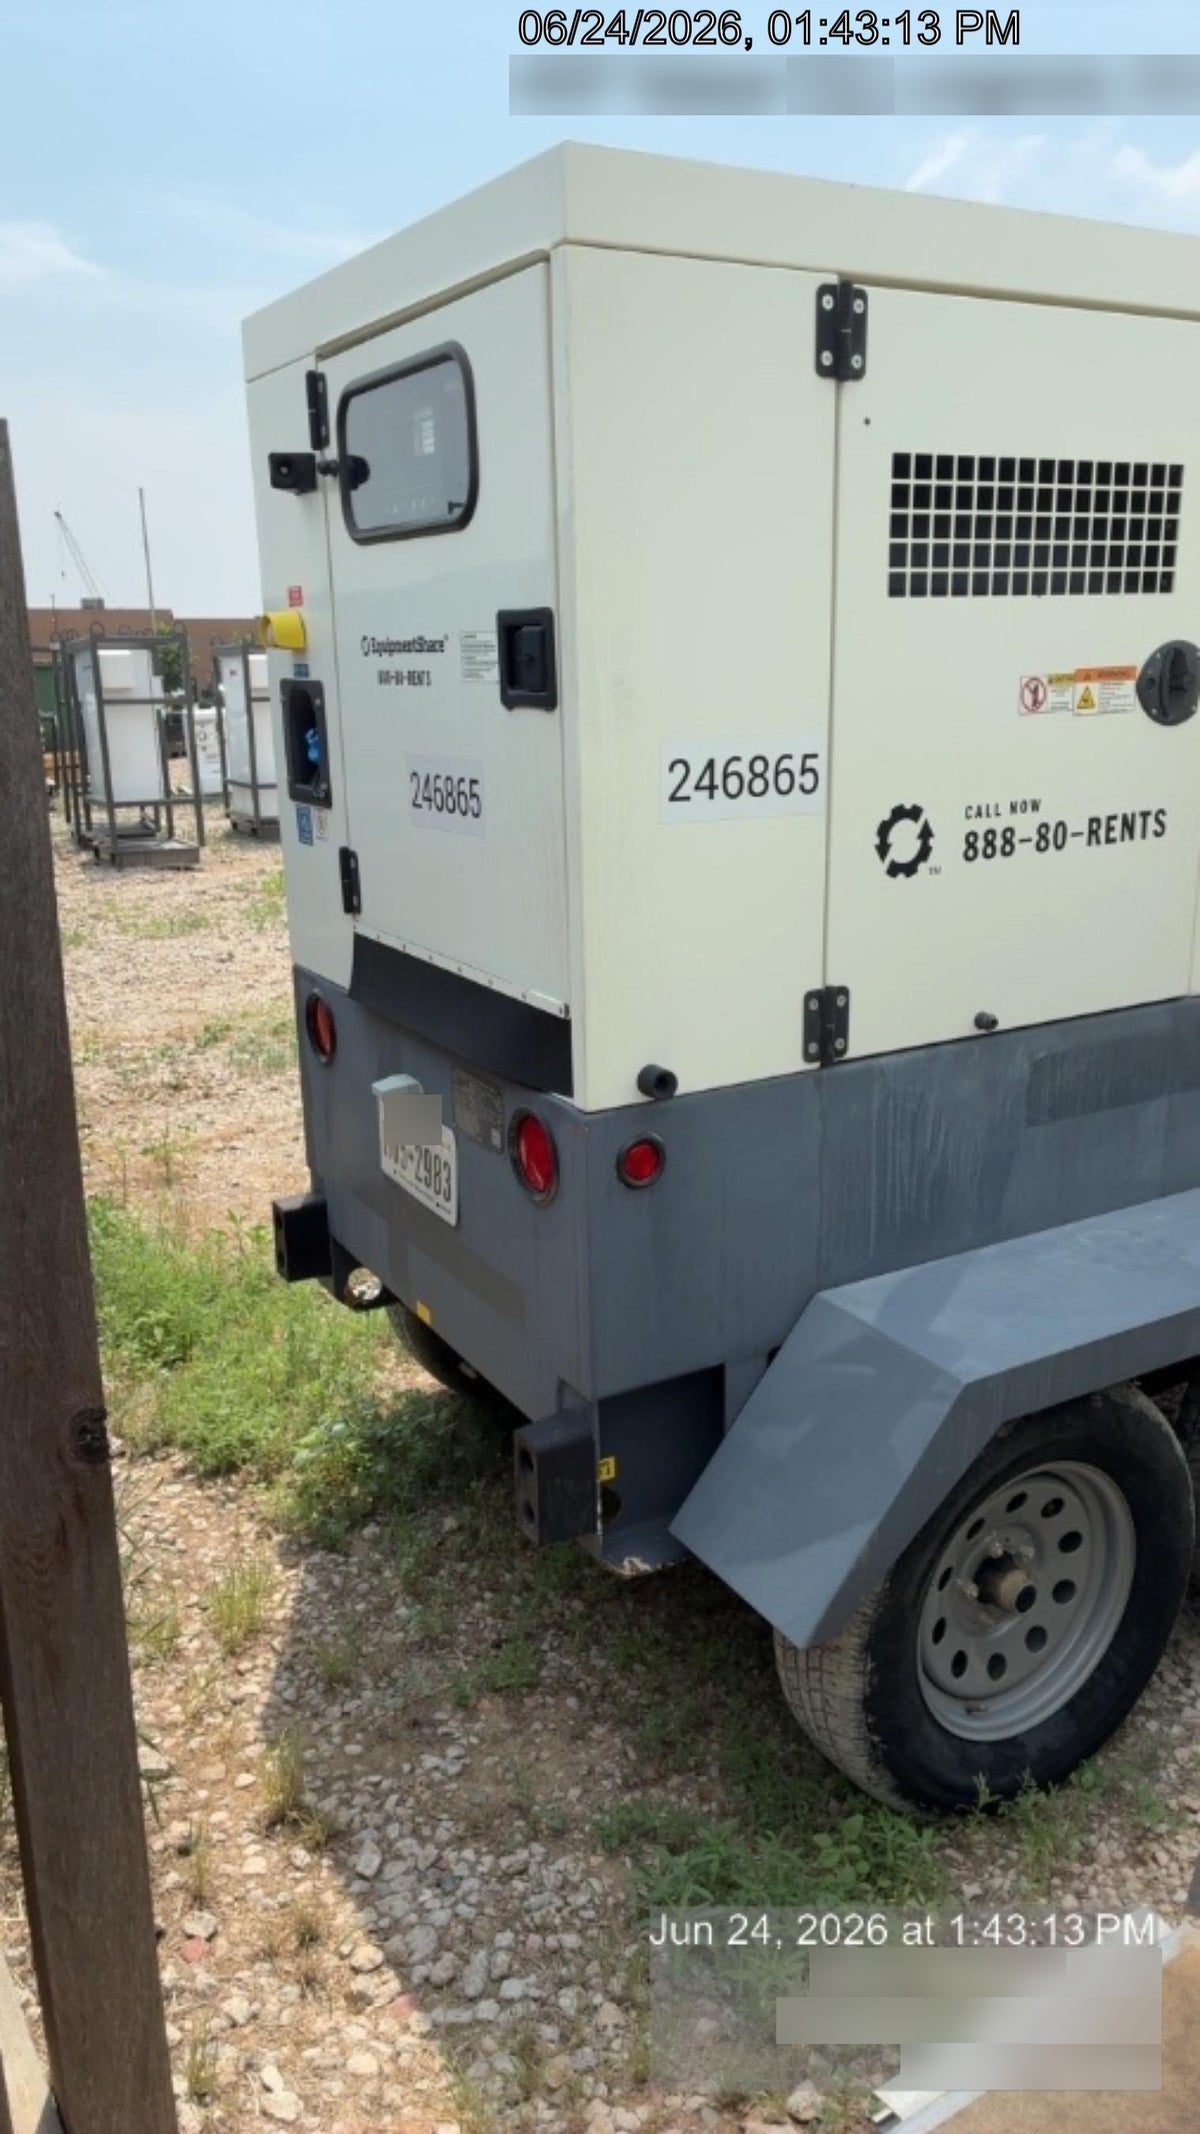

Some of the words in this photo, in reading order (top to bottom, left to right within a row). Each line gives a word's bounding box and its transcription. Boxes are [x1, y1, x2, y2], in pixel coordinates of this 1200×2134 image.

[410, 770, 482, 819] 246865
[667, 753, 820, 803] 246865
[965, 805, 1001, 820] CALL
[1009, 799, 1042, 814] NOW
[963, 807, 1168, 862] 888-80-RENTS
